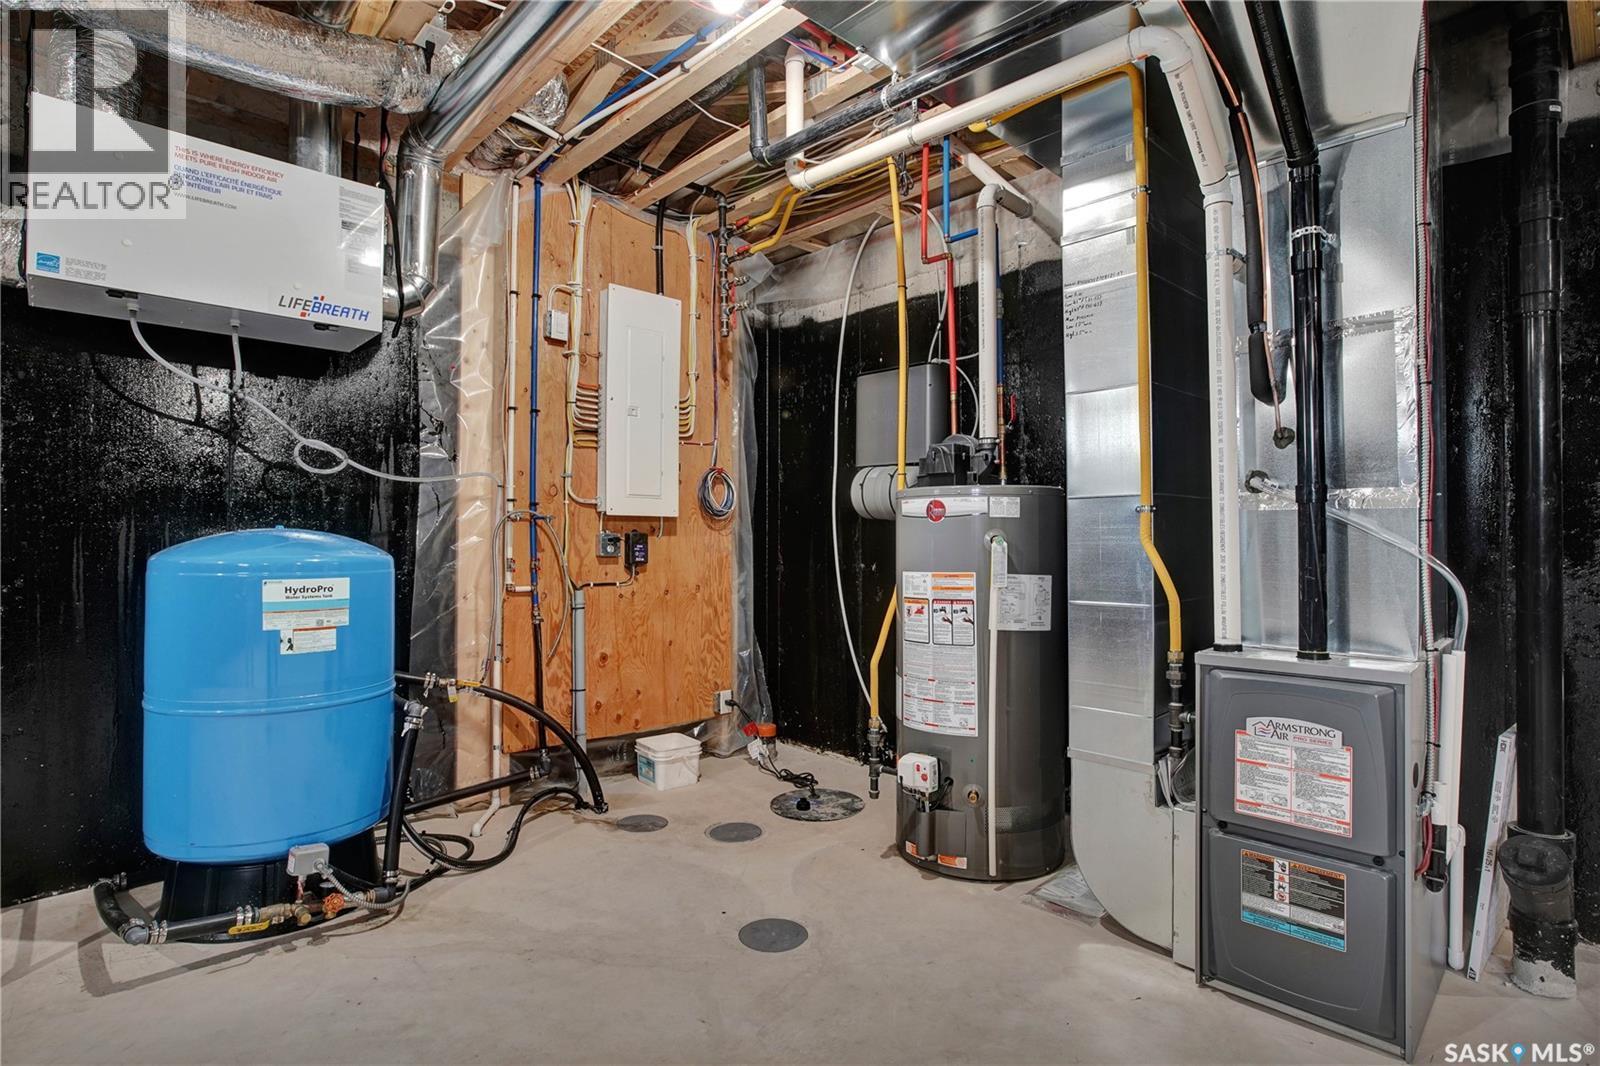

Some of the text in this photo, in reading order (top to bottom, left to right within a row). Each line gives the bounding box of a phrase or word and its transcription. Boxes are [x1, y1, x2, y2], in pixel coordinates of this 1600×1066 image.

[174, 152, 278, 183] MEETS PURE FRESH INDOOR AIR
[200, 151, 224, 162] WHERE
[226, 158, 250, 170] ENERGY
[252, 164, 284, 179] EFFICIENCY
[232, 185, 246, 194] PUR
[256, 191, 273, 200] FRAIS
[278, 296, 370, 321] LIFEBREATH
[284, 585, 334, 596] HydroPro
[1266, 720, 1336, 739] ARMSTRONG
[1270, 730, 1289, 740] AIR
